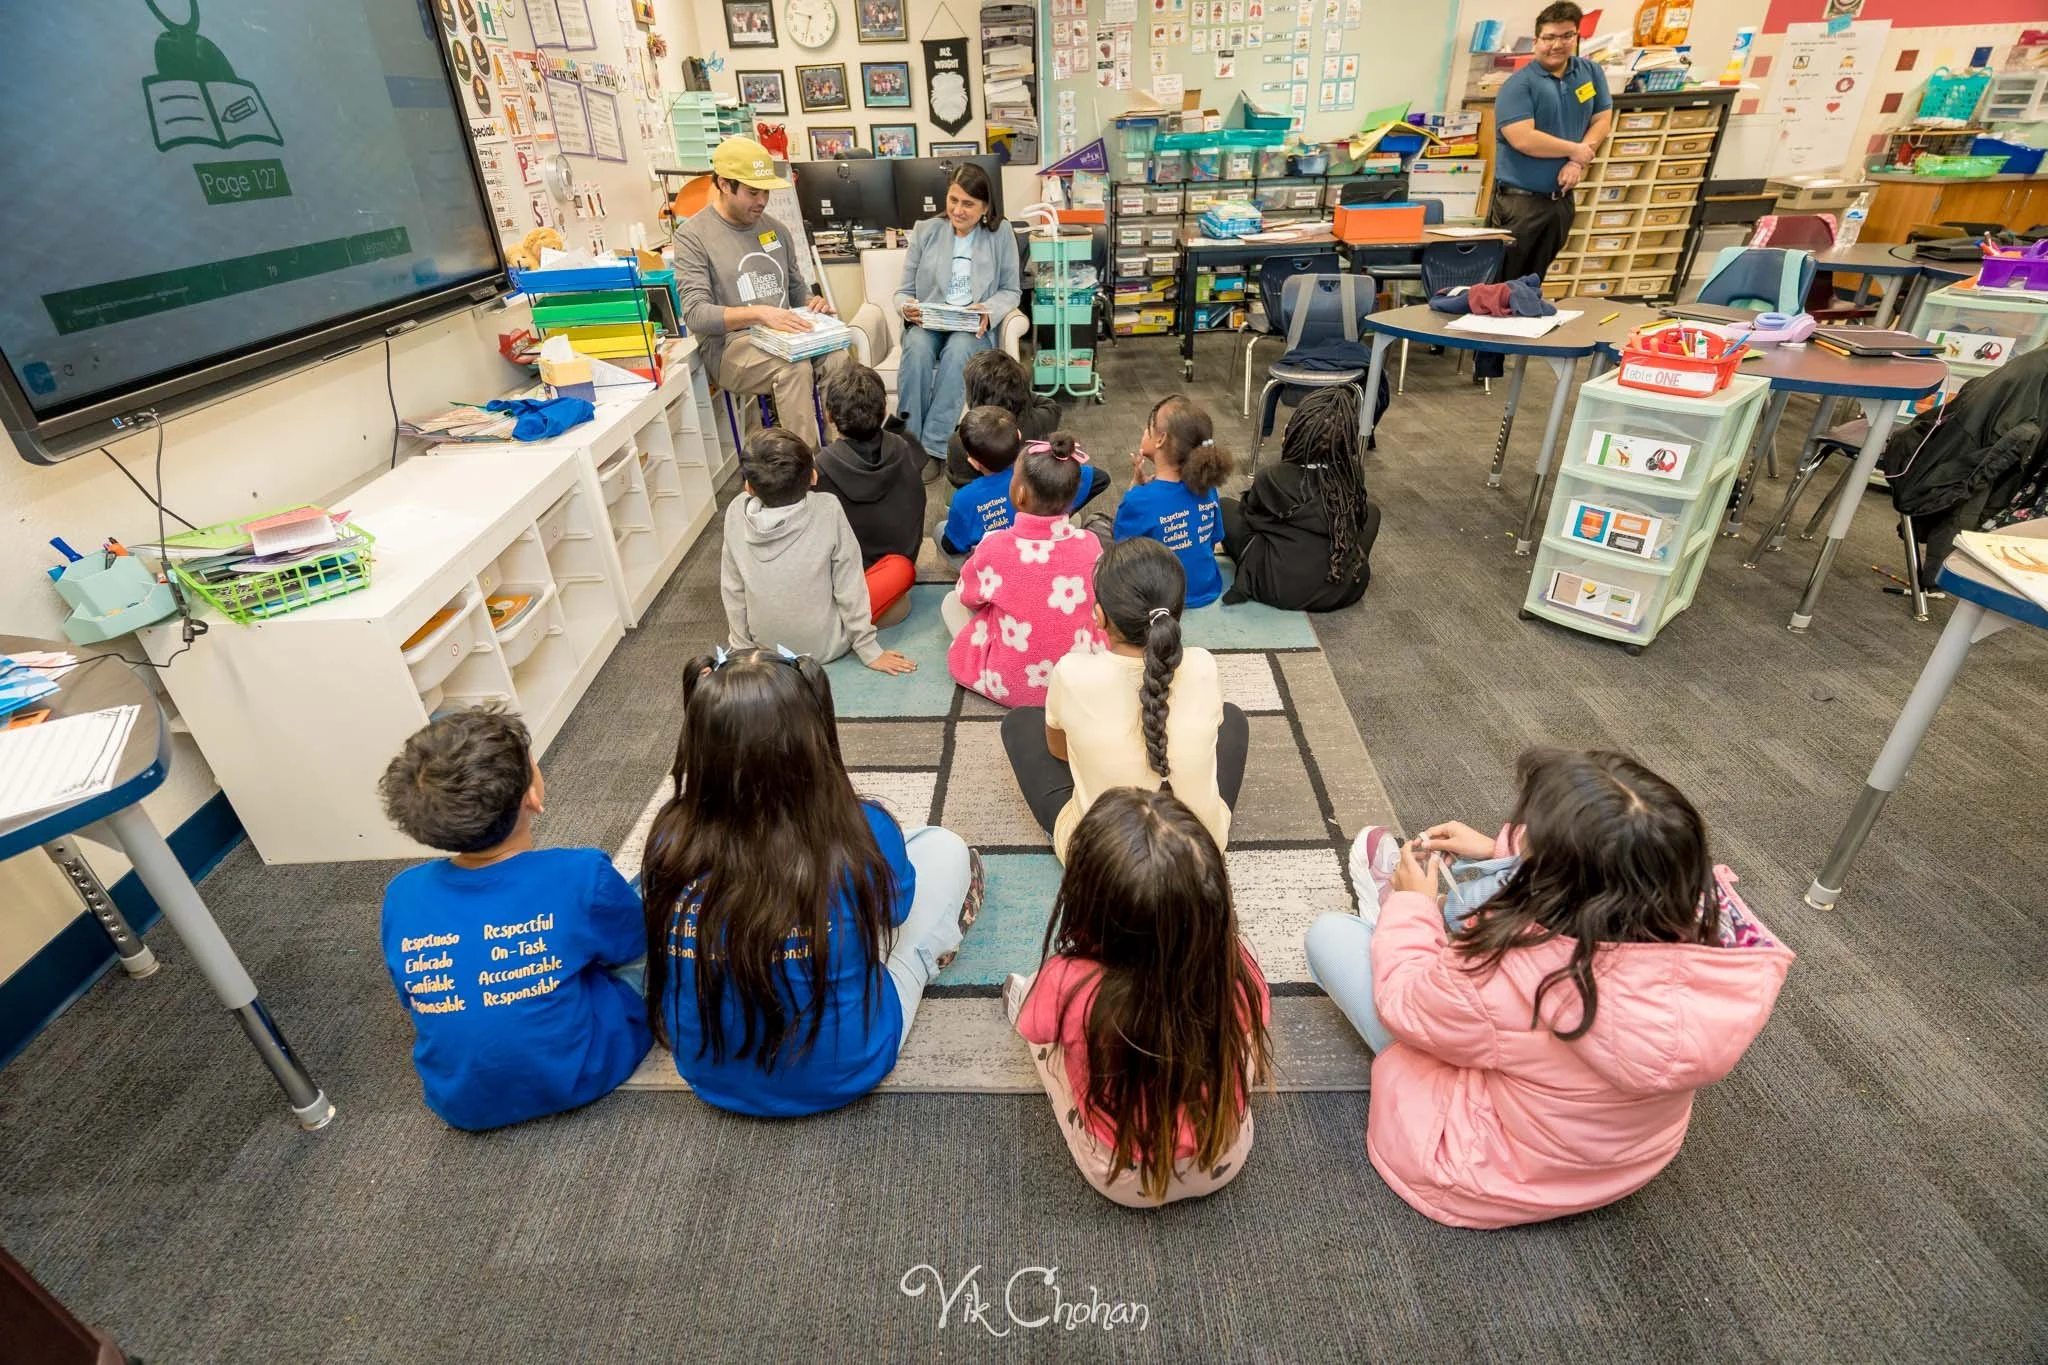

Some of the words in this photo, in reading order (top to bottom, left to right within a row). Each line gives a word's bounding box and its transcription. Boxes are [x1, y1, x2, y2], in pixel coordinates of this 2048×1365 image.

[478, 1, 496, 36] H
[493, 54, 508, 86] A
[504, 103, 522, 134] M
[517, 151, 529, 182] P
[200, 172, 251, 198] Page
[251, 167, 277, 191] 127
[532, 200, 545, 227] S
[1655, 371, 1682, 387] ONE
[484, 912, 554, 941] Respectful
[401, 932, 460, 953] Respetuoso
[490, 937, 548, 962] On-Task
[405, 951, 454, 974] Enfocado
[404, 974, 455, 994] Confiable
